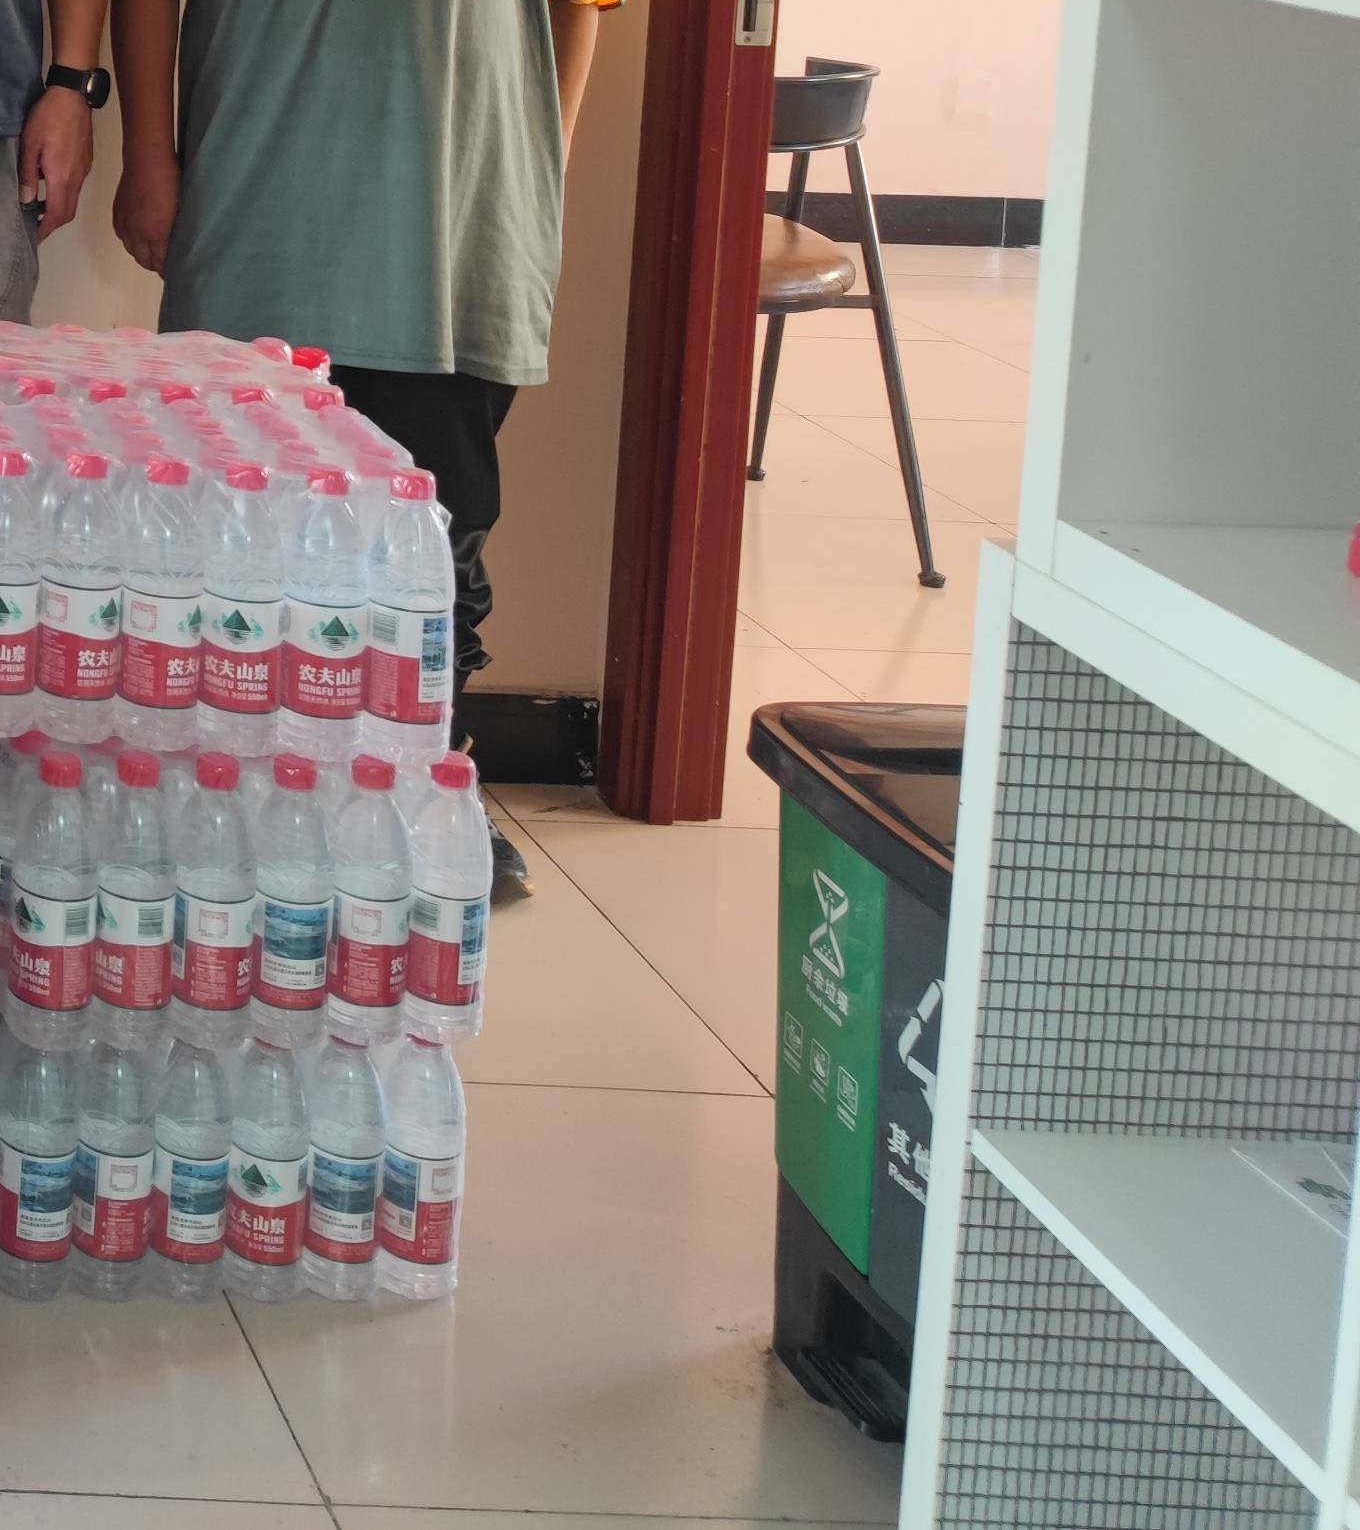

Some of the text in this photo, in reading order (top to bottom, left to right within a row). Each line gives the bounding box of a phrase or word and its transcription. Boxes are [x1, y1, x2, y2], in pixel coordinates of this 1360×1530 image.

[204, 655, 269, 681] 农夫山泉
[298, 664, 361, 686] 农夫山泉
[237, 681, 269, 692] SPRING
[298, 683, 333, 696] NONGFU
